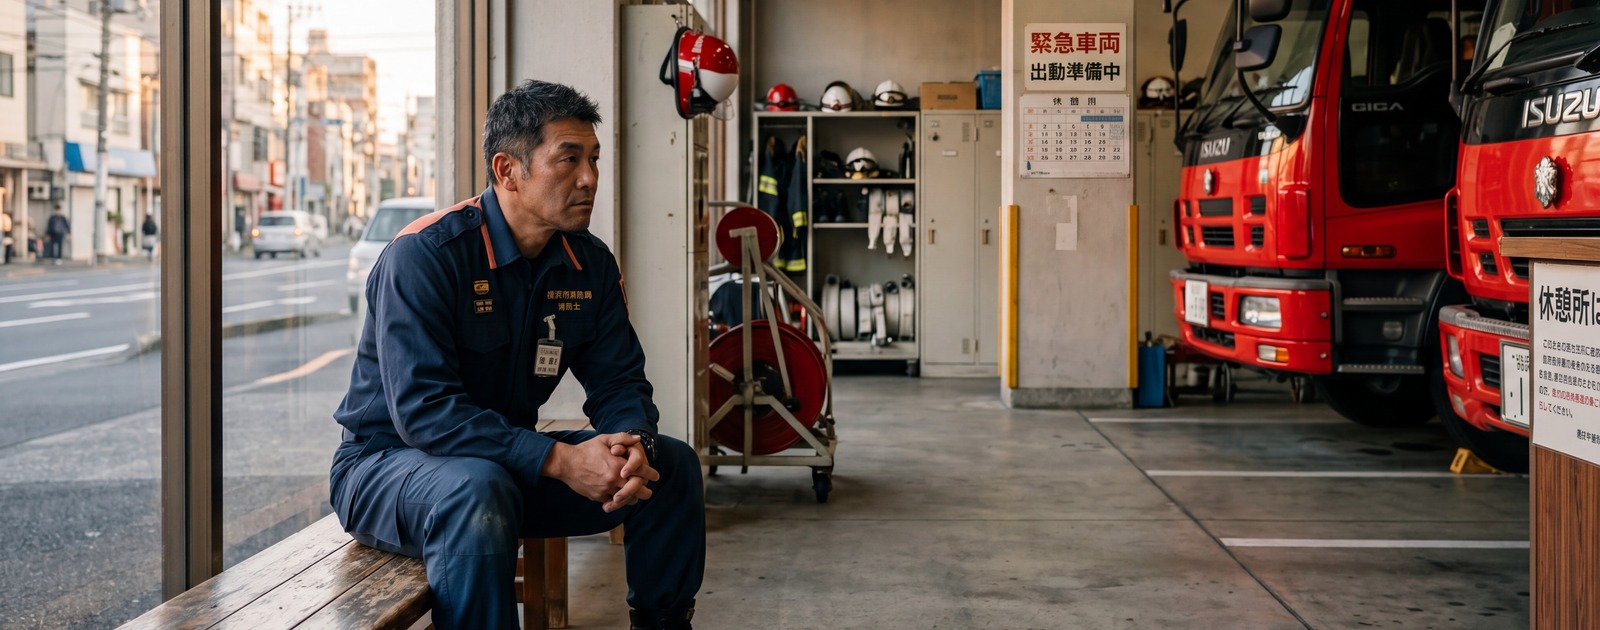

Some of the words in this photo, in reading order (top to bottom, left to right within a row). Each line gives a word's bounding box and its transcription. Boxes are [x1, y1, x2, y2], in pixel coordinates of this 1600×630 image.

[1031, 32, 1120, 54] 緊急車両
[1031, 62, 1120, 81] 出動準備中
[1352, 102, 1404, 112] GIGA
[1522, 88, 1600, 128] ISUZU
[1200, 137, 1231, 158] ISUZU
